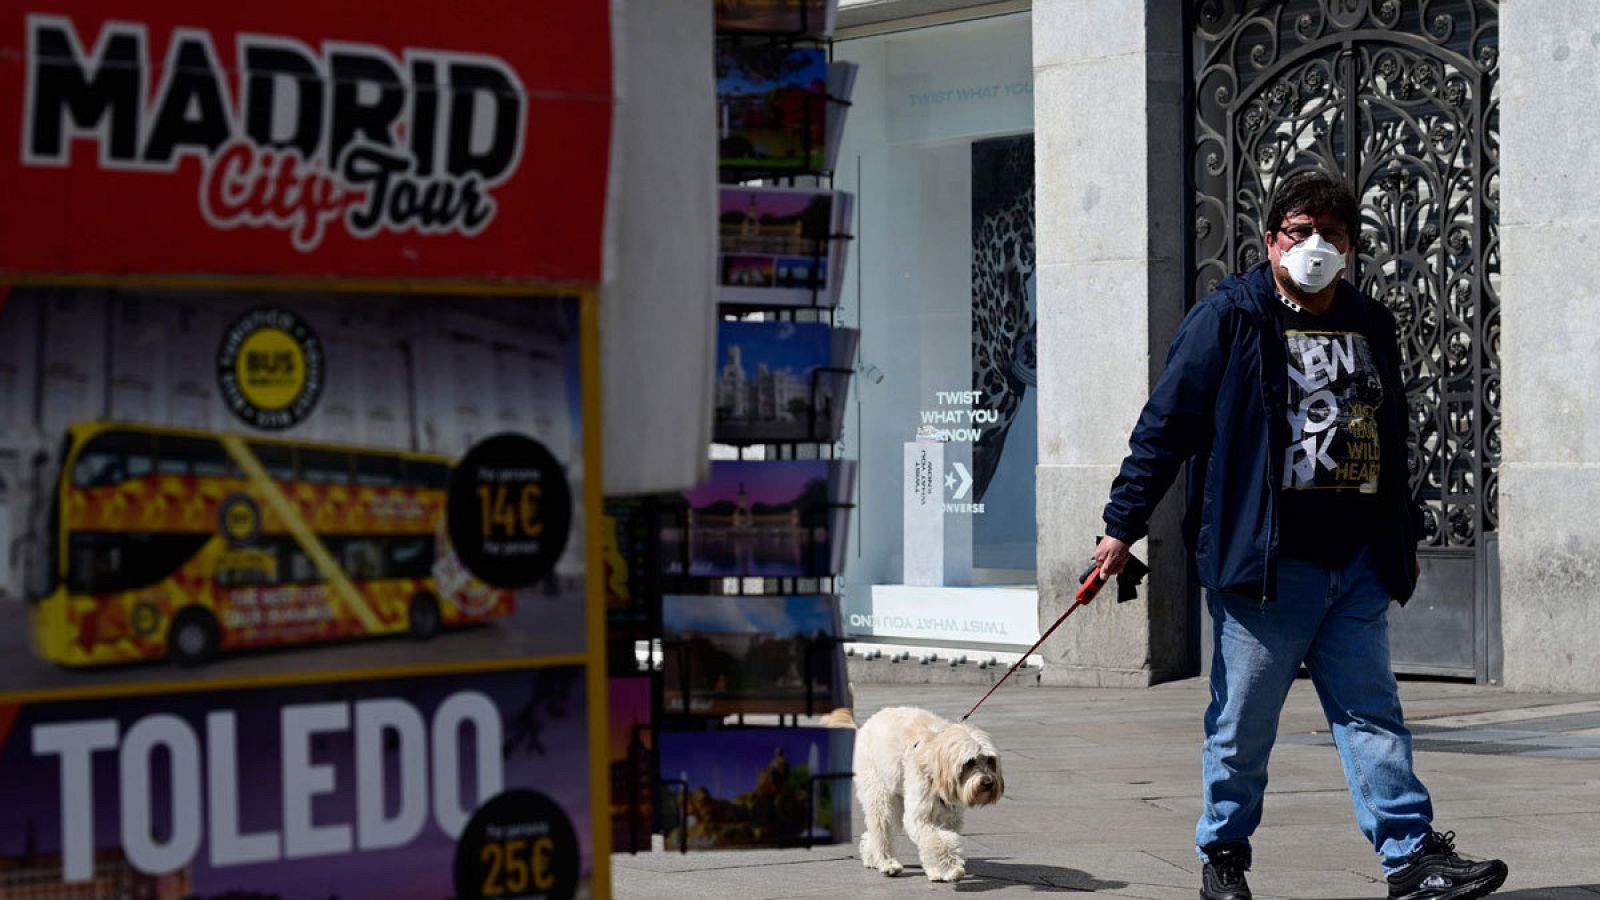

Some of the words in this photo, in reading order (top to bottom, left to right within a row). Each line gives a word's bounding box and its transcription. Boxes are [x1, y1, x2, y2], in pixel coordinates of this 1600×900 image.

[22, 14, 528, 187] MADRID
[909, 91, 953, 106] TWIST
[956, 86, 1000, 101] WHAT
[201, 137, 356, 251] City
[338, 146, 498, 238] Tour
[246, 350, 297, 374] BUS
[936, 391, 983, 405] TWIST
[920, 410, 964, 424] WHAT
[965, 409, 999, 423] YOU
[475, 483, 544, 539] 14€
[934, 503, 985, 513] ONVERSE
[849, 613, 880, 628] KNO
[882, 615, 913, 629] YOU
[917, 617, 960, 632] WHAT
[31, 690, 506, 884] TOLEDO
[480, 836, 557, 897] 25€
